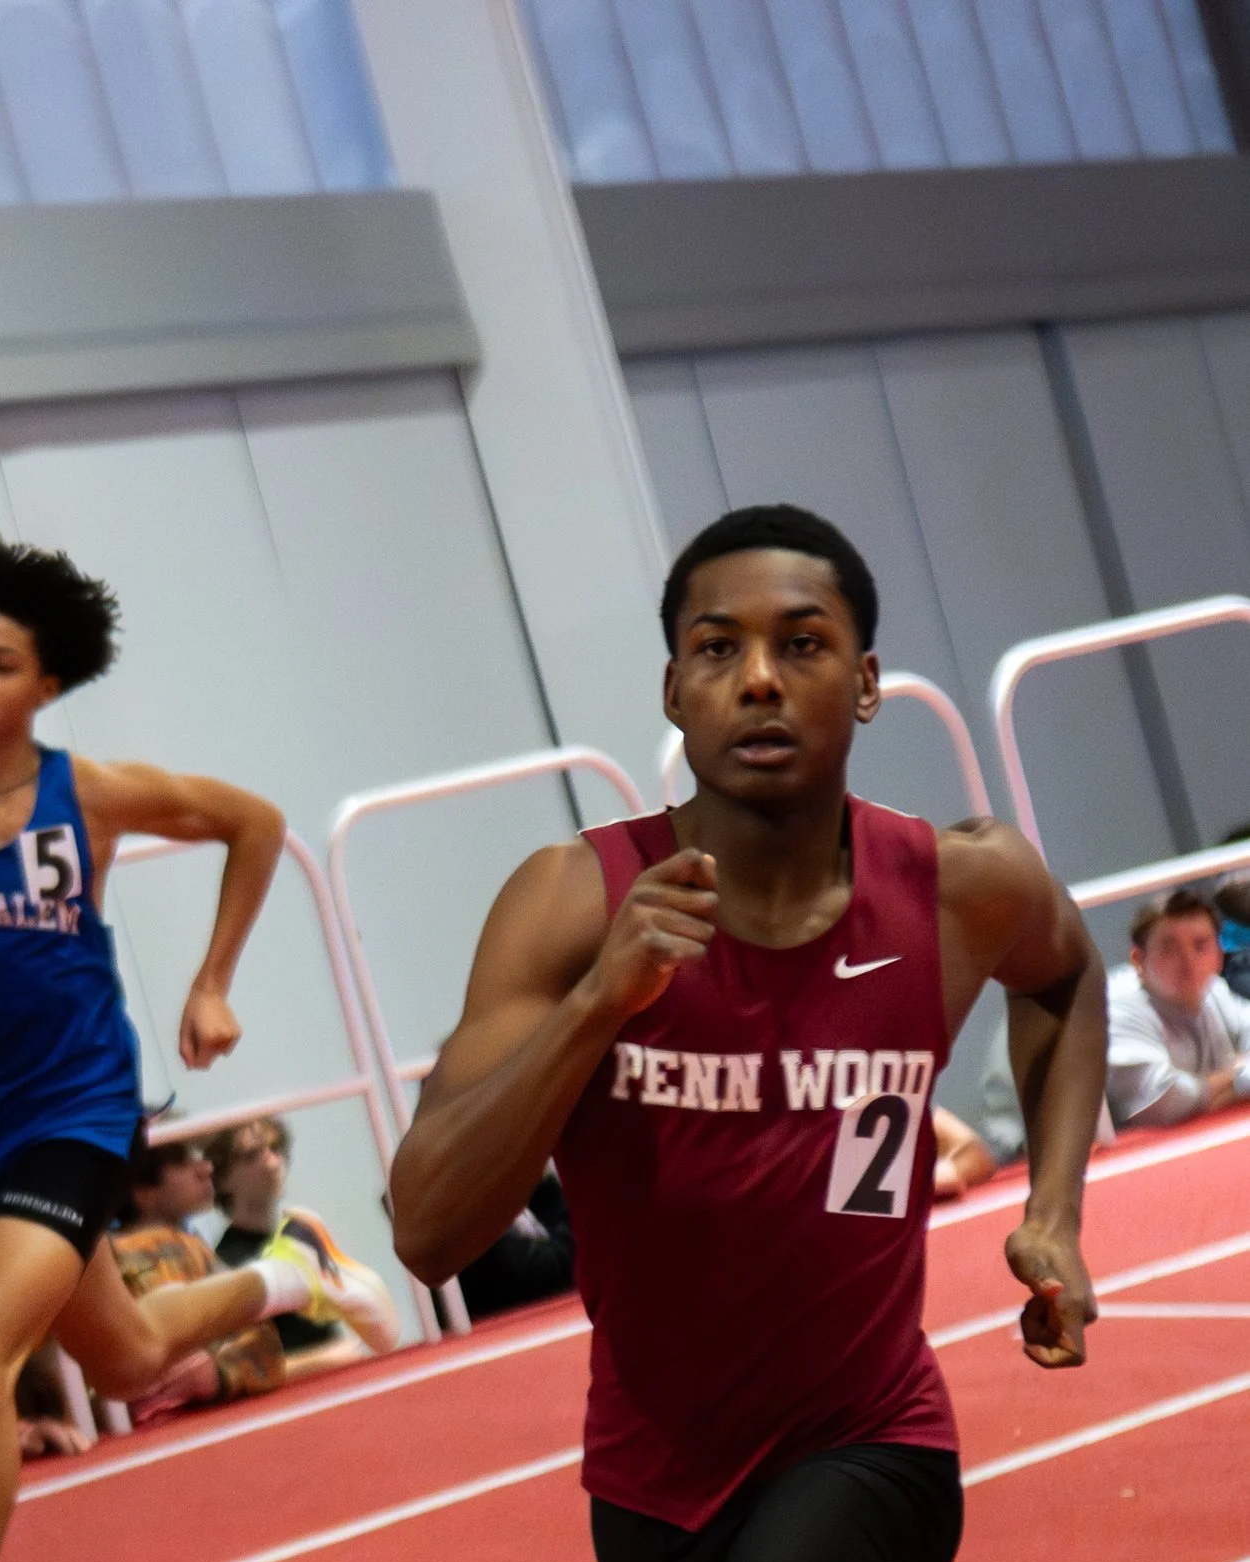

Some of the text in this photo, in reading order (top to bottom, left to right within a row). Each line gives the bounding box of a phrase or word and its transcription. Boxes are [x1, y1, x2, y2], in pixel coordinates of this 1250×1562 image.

[36, 828, 74, 901] 5
[611, 1042, 934, 1112] PENN WOOD
[841, 1094, 910, 1215] 2
